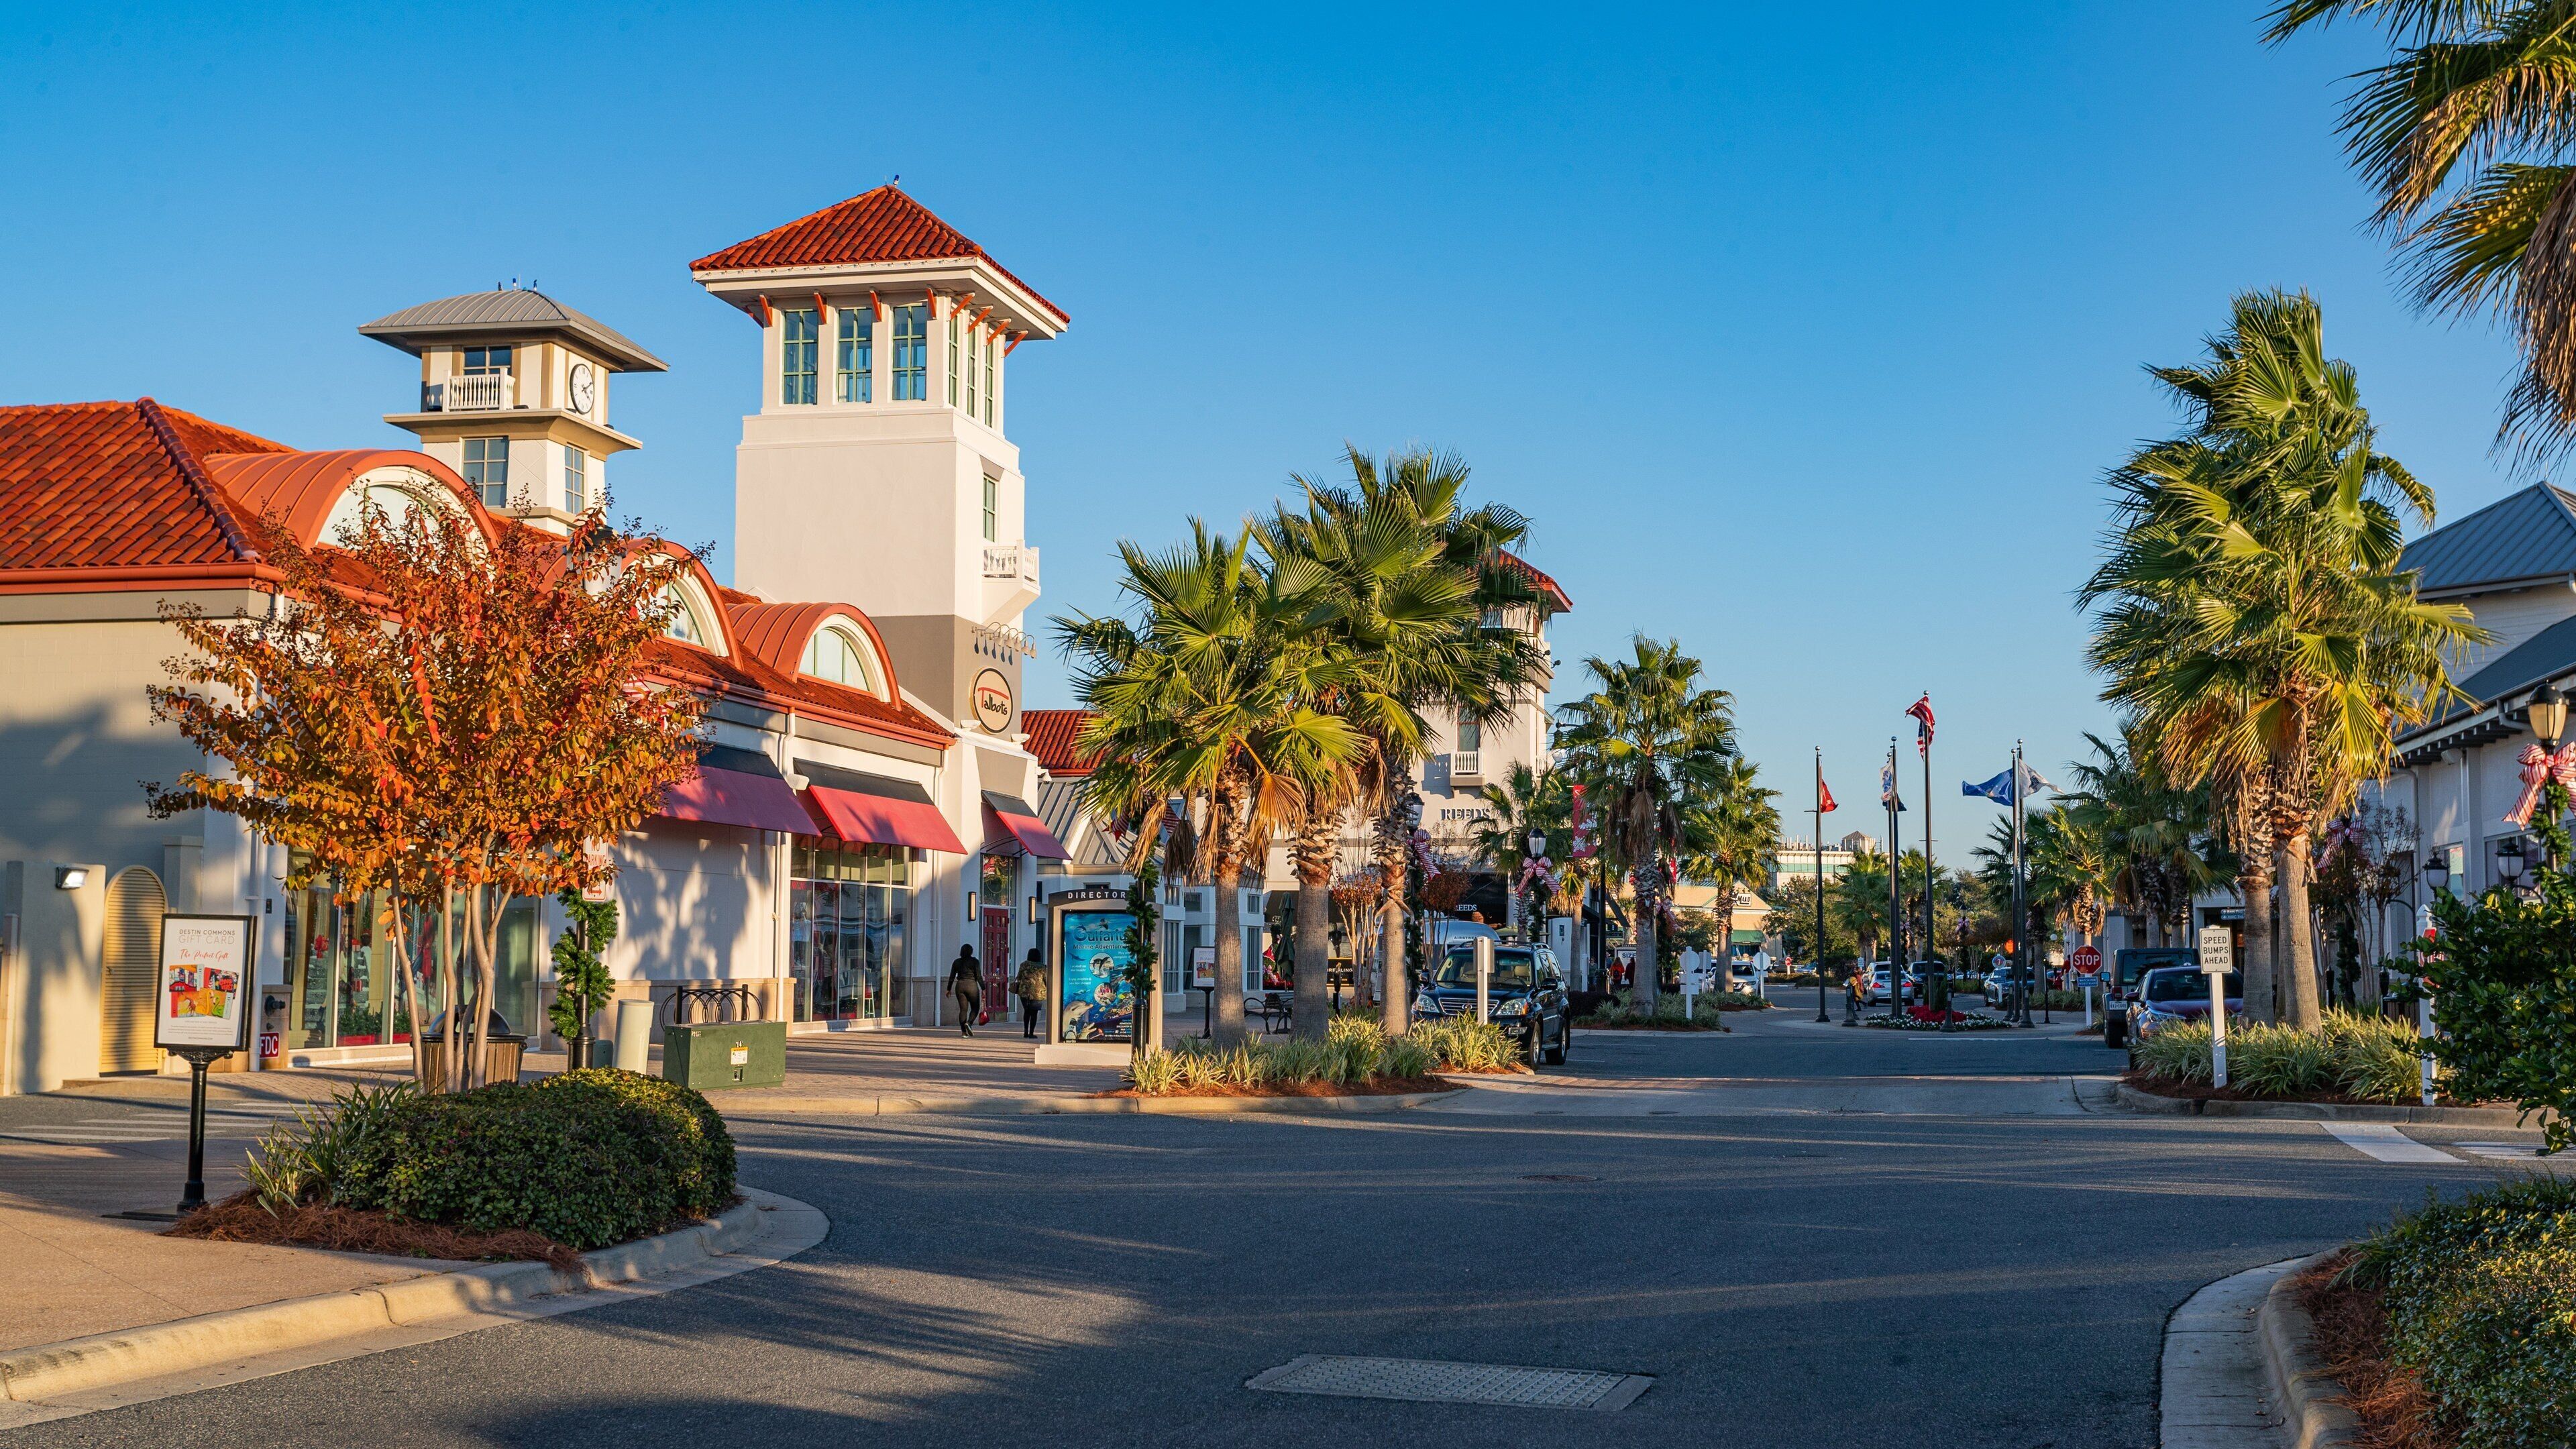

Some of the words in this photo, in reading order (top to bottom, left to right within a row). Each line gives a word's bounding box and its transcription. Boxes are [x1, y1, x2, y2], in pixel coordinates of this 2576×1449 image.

[977, 687, 1009, 715] Talbots
[1440, 808, 1491, 820] REEDS
[588, 854, 606, 867] ARKING
[178, 934, 201, 943] GIFT
[206, 936, 235, 945] CARD
[1074, 926, 1126, 941] Gulfariu
[180, 949, 191, 959] The
[193, 950, 215, 961] Perfect
[215, 950, 229, 962] Gift
[2074, 955, 2100, 965] STOP
[260, 1035, 278, 1055] FDC
